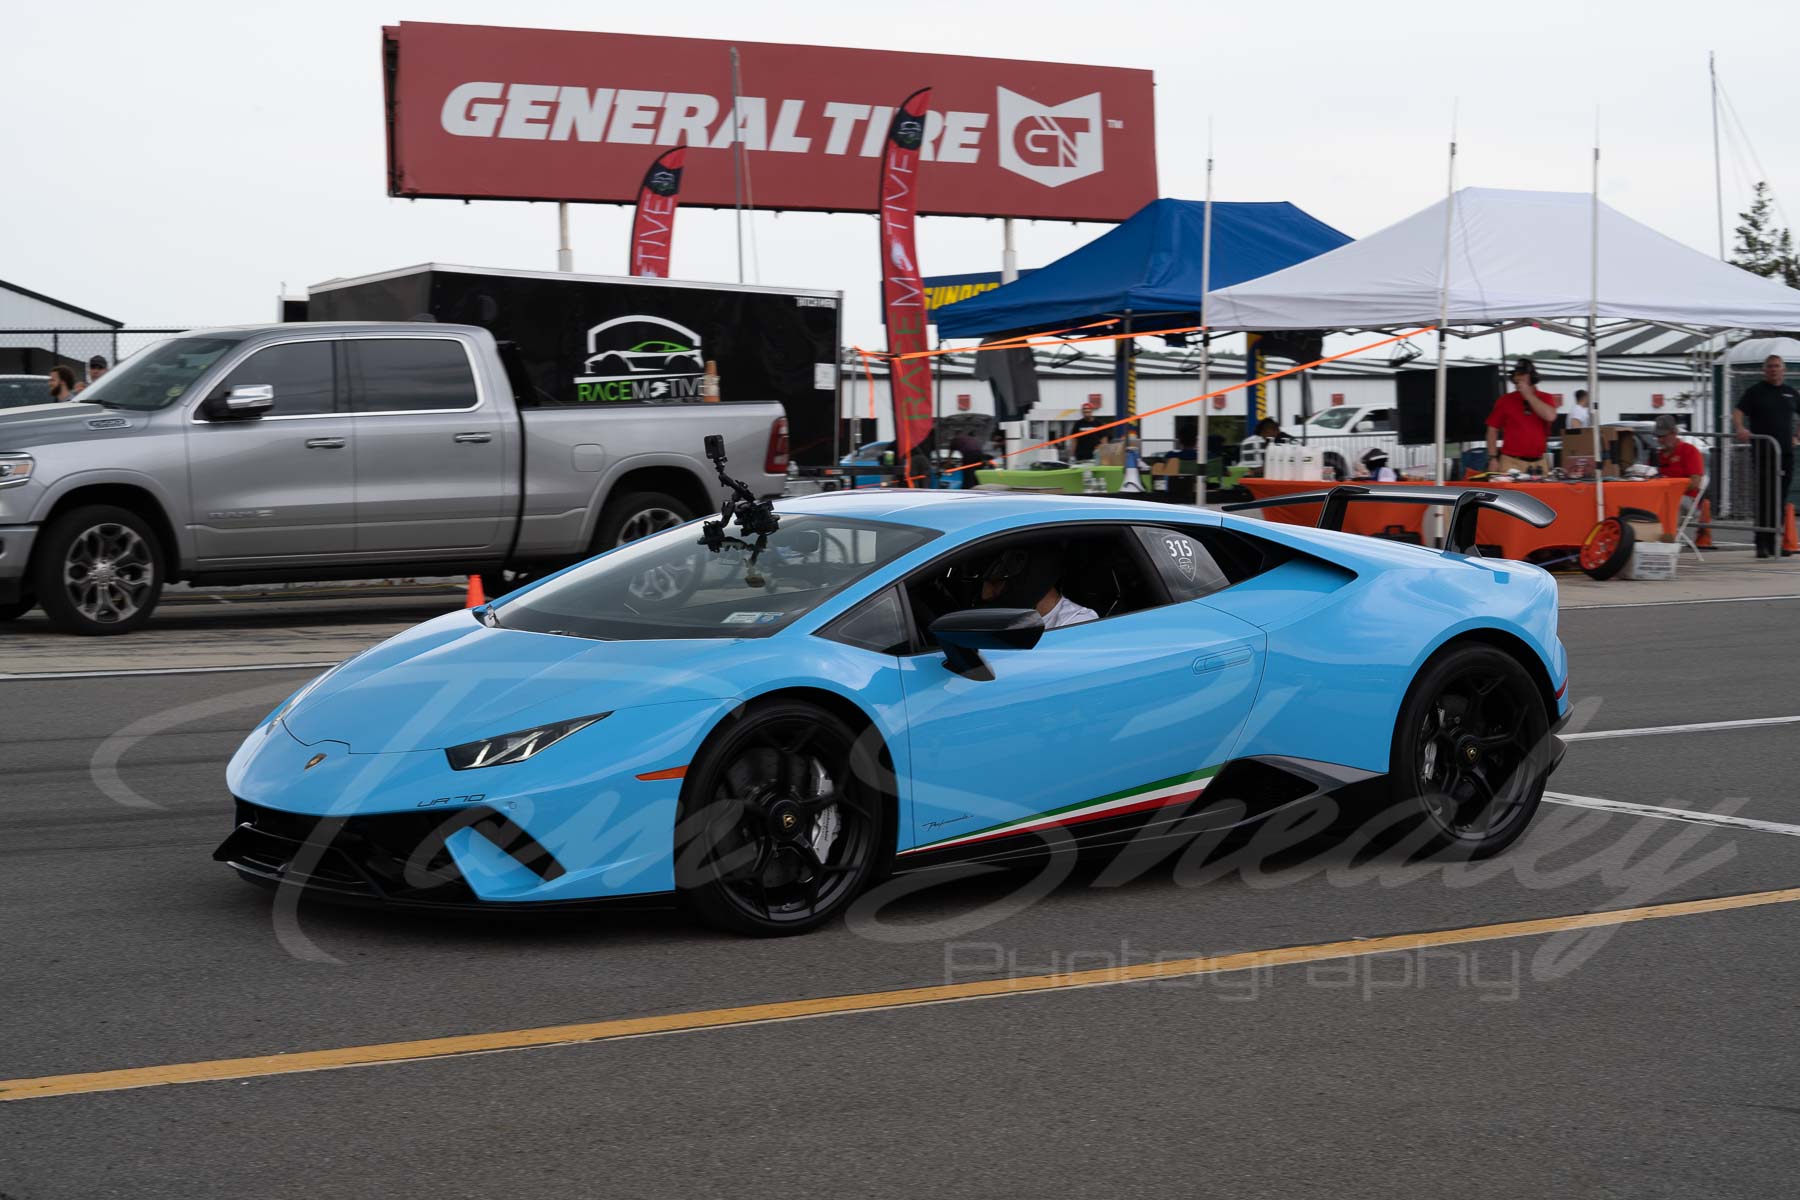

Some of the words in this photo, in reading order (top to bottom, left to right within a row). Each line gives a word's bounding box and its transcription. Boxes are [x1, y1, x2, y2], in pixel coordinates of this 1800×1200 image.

[440, 81, 812, 153] GENERAL
[636, 193, 674, 277] TIVE
[1165, 539, 1193, 557] 315
